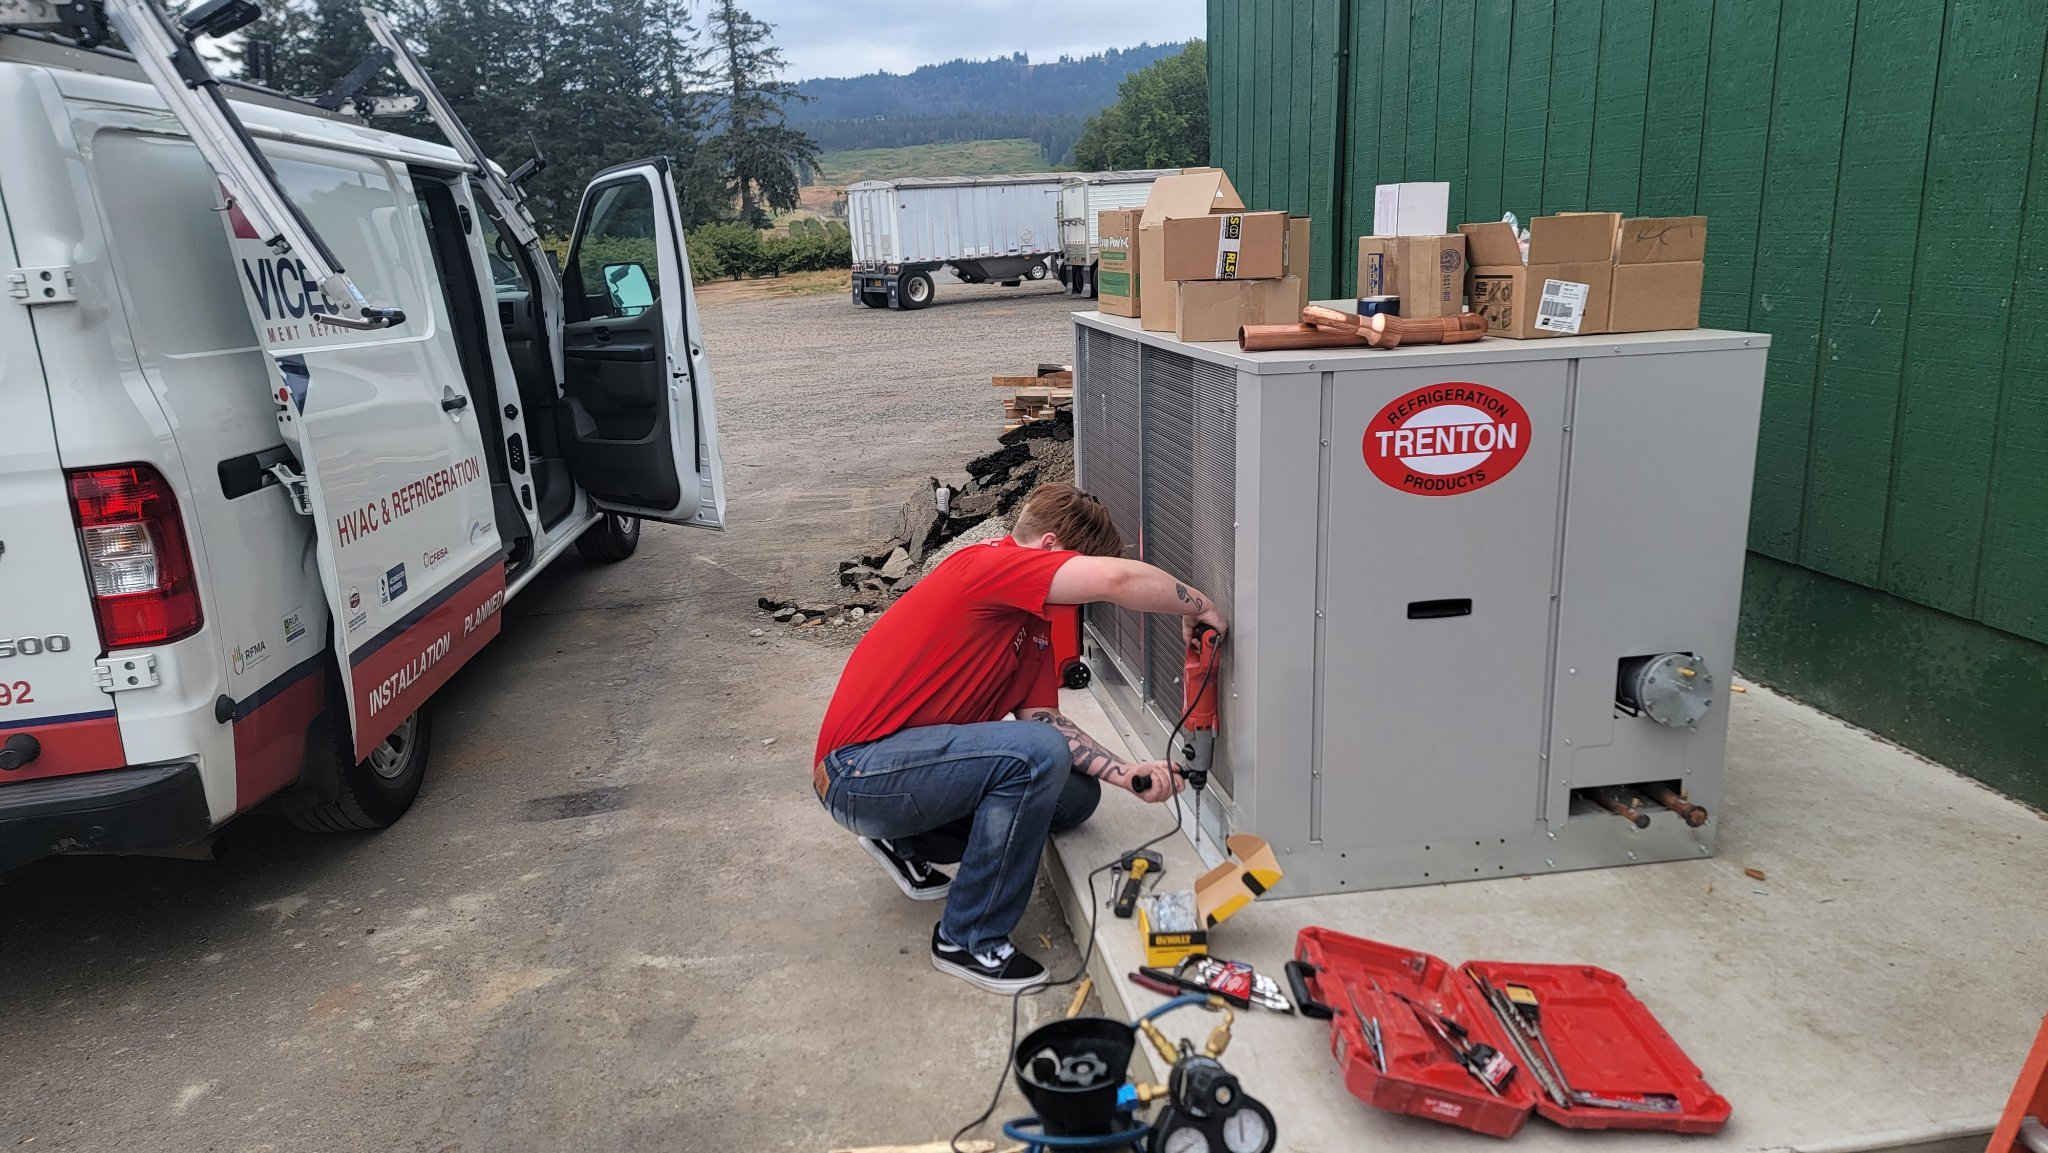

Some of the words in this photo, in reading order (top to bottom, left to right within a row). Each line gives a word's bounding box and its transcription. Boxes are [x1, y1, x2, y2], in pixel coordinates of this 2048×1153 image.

[1225, 253, 1236, 272] RLS
[267, 325, 300, 343] MENT
[1387, 388, 1509, 424] REFRIGERATION
[1375, 422, 1518, 458] TRENTON
[1404, 469, 1486, 491] PRODUCTS
[337, 502, 379, 547] HVAC
[381, 497, 391, 526] &
[392, 455, 481, 519] REFRIGERATION
[245, 640, 266, 660] RFMA
[369, 631, 450, 717] INSTALLATION
[463, 589, 503, 638] PLANNED
